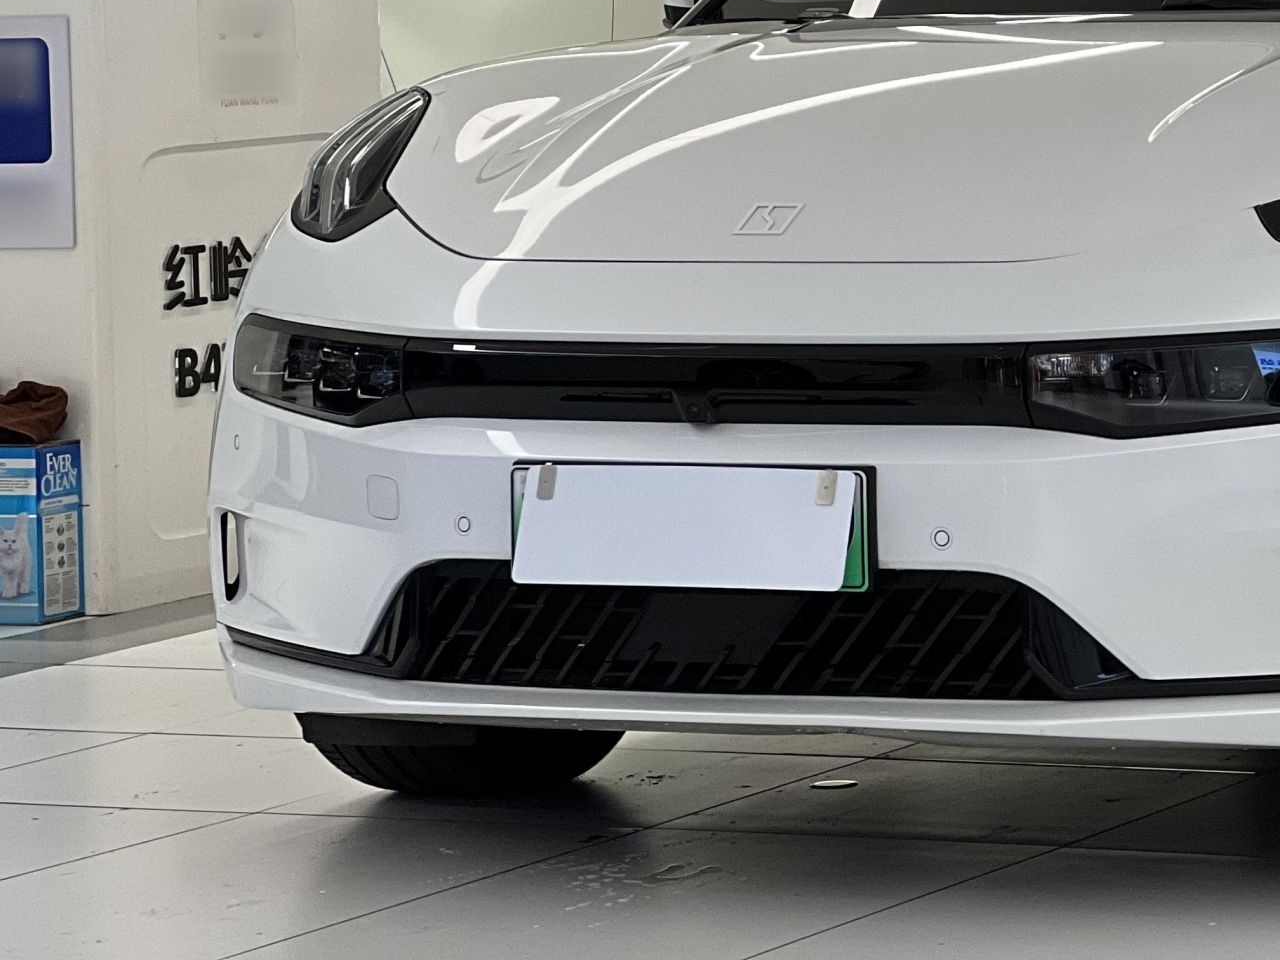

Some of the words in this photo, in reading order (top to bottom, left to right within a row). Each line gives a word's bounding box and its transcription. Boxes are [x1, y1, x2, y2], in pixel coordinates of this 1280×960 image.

[175, 342, 226, 398] BA
[46, 452, 73, 474] EVER
[41, 468, 78, 497] CLEAN
